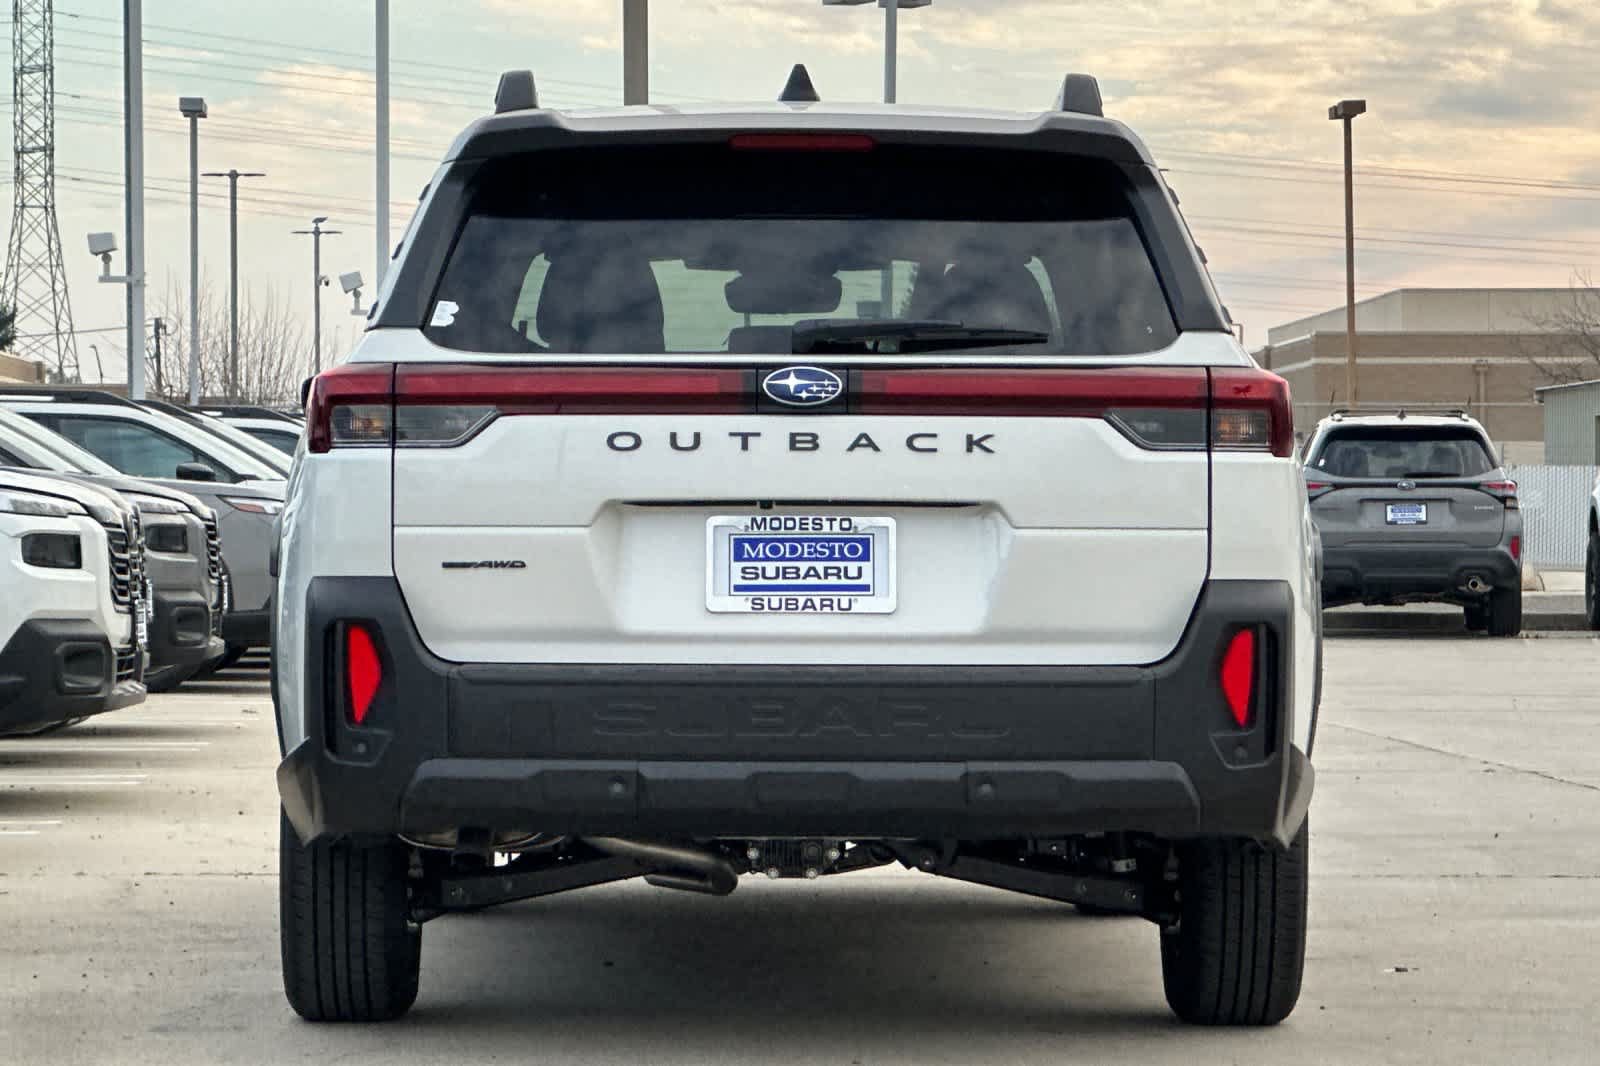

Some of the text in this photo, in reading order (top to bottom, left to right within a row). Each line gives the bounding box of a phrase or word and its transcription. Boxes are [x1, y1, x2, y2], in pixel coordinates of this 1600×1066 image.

[606, 431, 995, 454] OUTBACK
[750, 517, 853, 532] MODESTO
[743, 543, 863, 558] MODESTO
[740, 566, 863, 581] SUBARU
[751, 597, 853, 612] SUBARU
[592, 701, 1012, 737] SBAR
